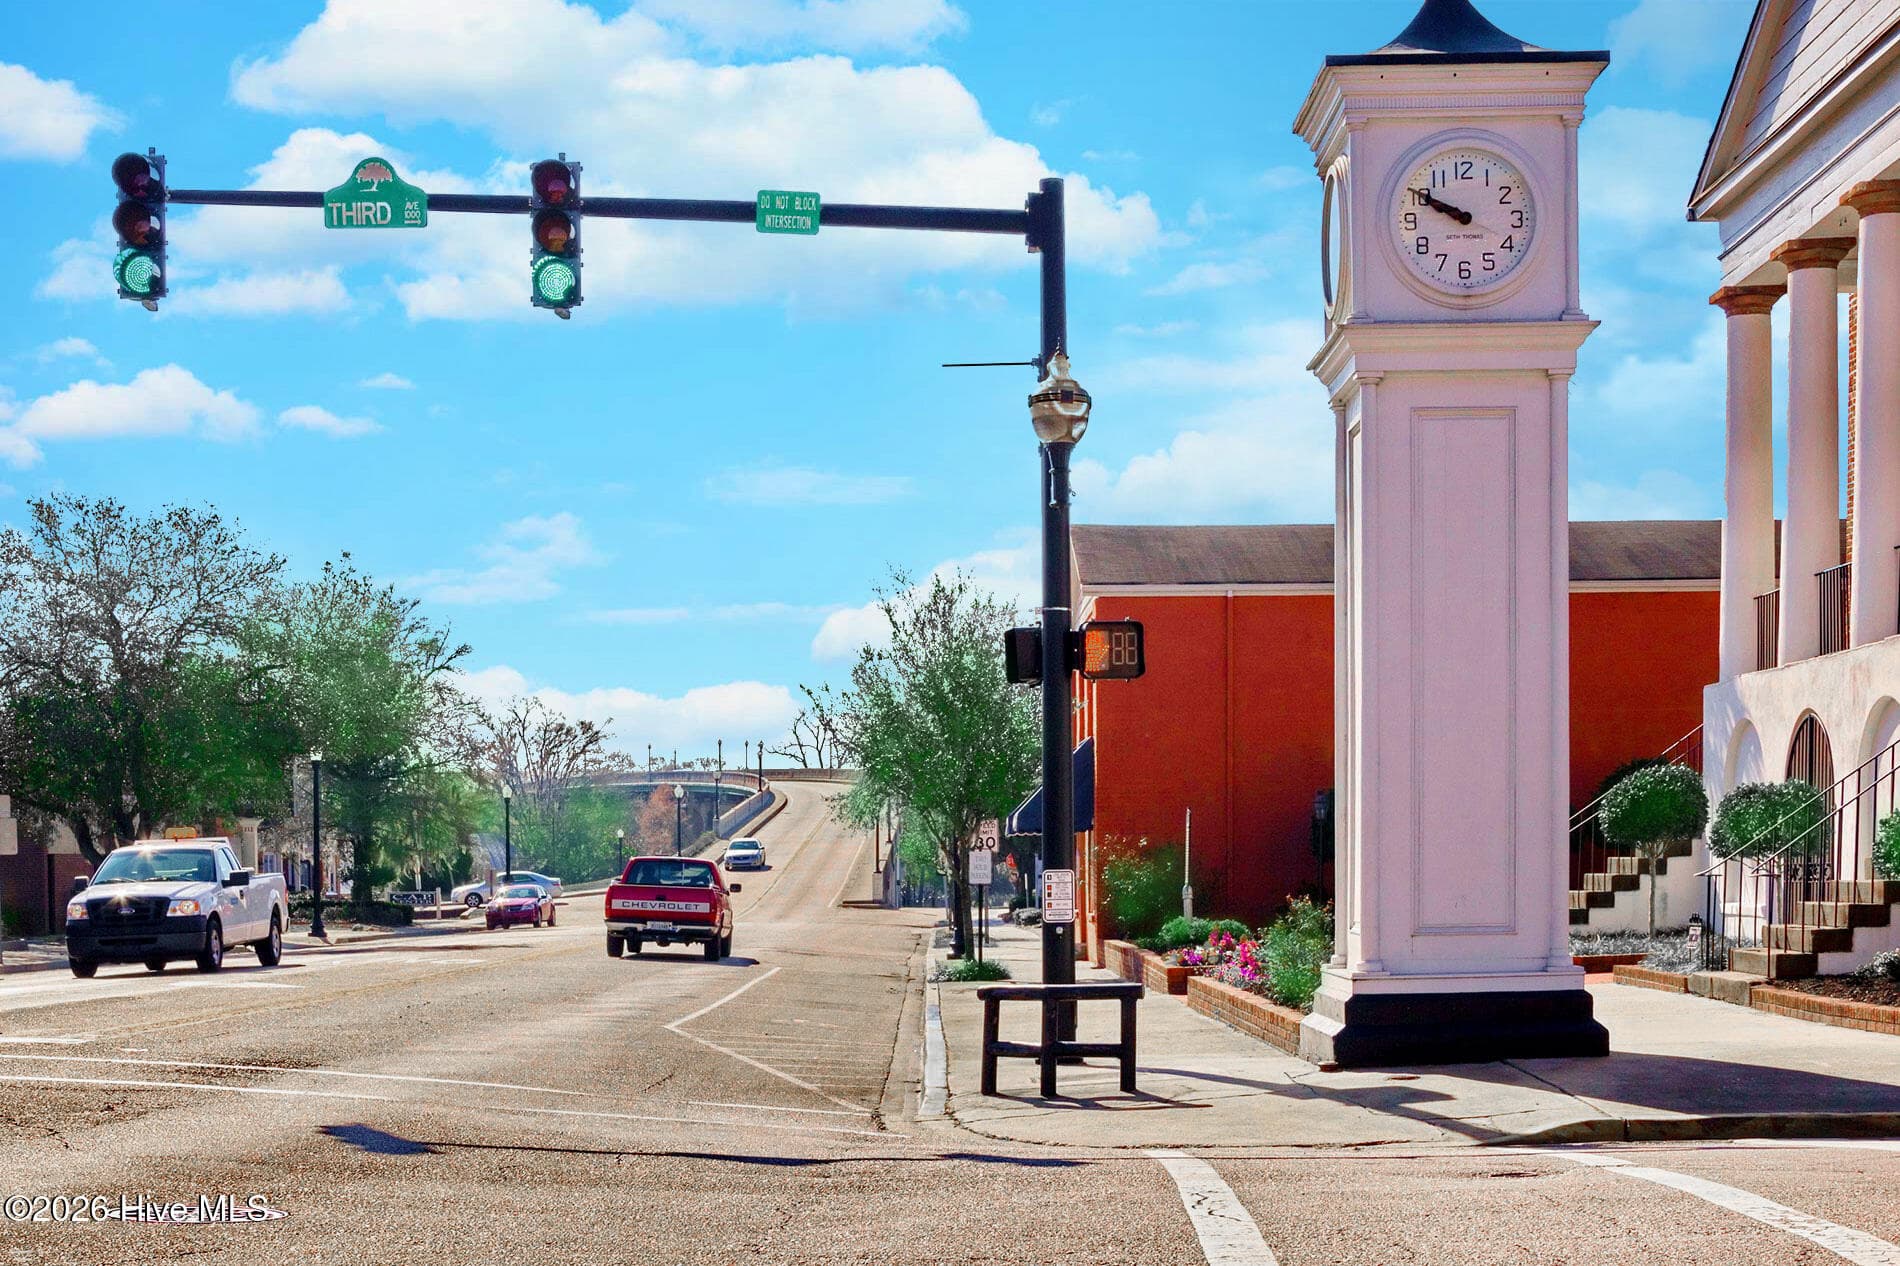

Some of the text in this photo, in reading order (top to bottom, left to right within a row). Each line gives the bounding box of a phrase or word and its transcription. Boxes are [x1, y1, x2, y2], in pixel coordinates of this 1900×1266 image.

[1432, 169, 1446, 188] 11
[1454, 161, 1474, 180] 12
[760, 195, 817, 211] DO NOT BLOCK
[1412, 187, 1431, 207] 10
[1498, 185, 1513, 205] 2
[328, 201, 392, 226] THIRD
[405, 201, 419, 210] AVE
[764, 214, 812, 230] INTERSECTION
[1404, 212, 1418, 231] 9
[1510, 210, 1524, 229] 3
[1415, 236, 1429, 255] 8
[1499, 234, 1515, 253] 4
[1434, 253, 1448, 272] 7
[1457, 260, 1472, 280] 6
[1482, 252, 1496, 271] 5
[621, 900, 701, 911] CHEVROLET
